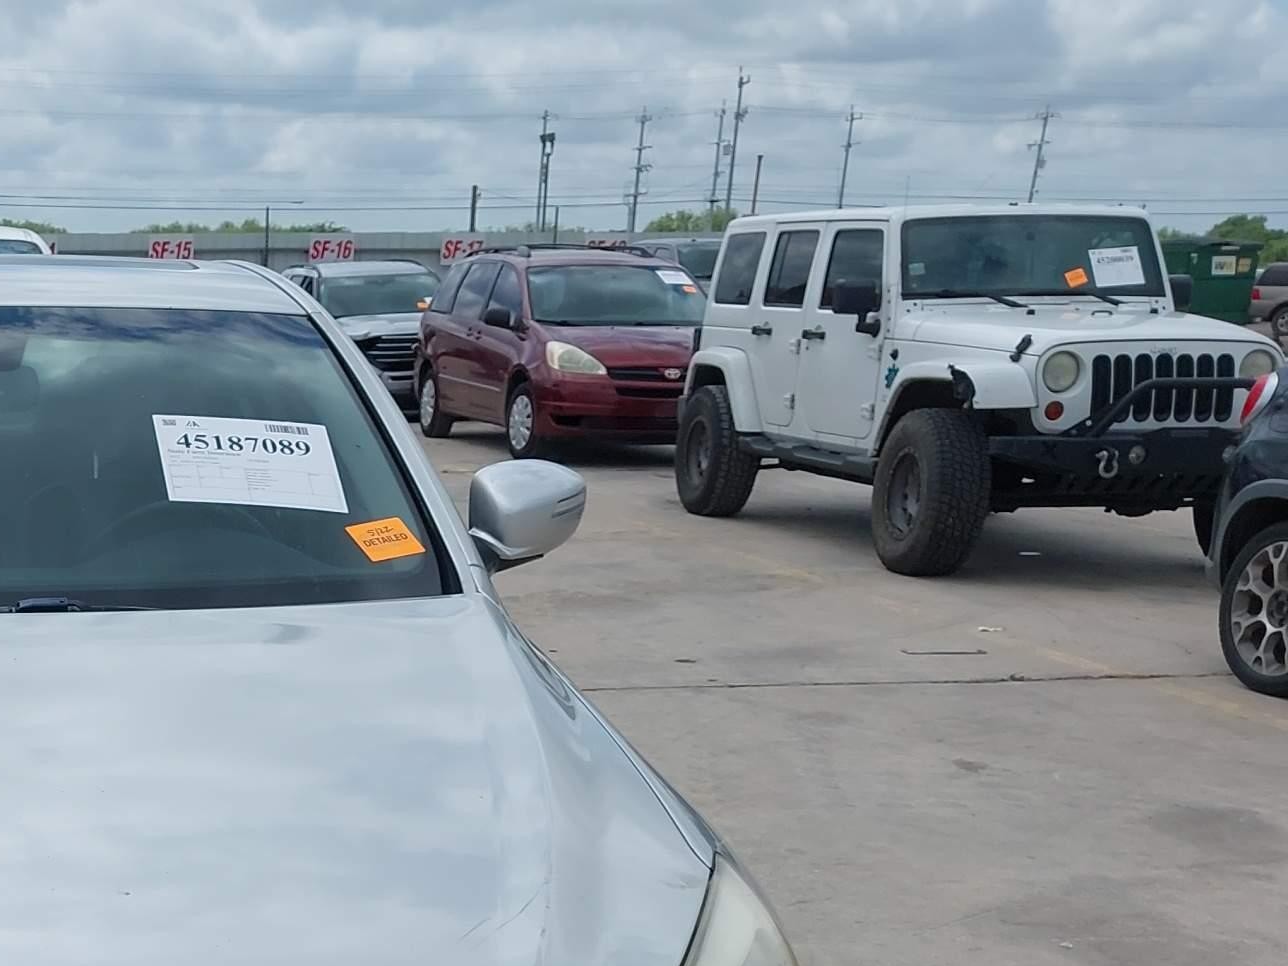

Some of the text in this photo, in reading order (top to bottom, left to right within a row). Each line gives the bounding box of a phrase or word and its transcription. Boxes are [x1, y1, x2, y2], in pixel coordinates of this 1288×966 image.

[150, 240, 192, 259] SF-15
[311, 239, 353, 259] SF-16
[175, 432, 312, 457] 45187089
